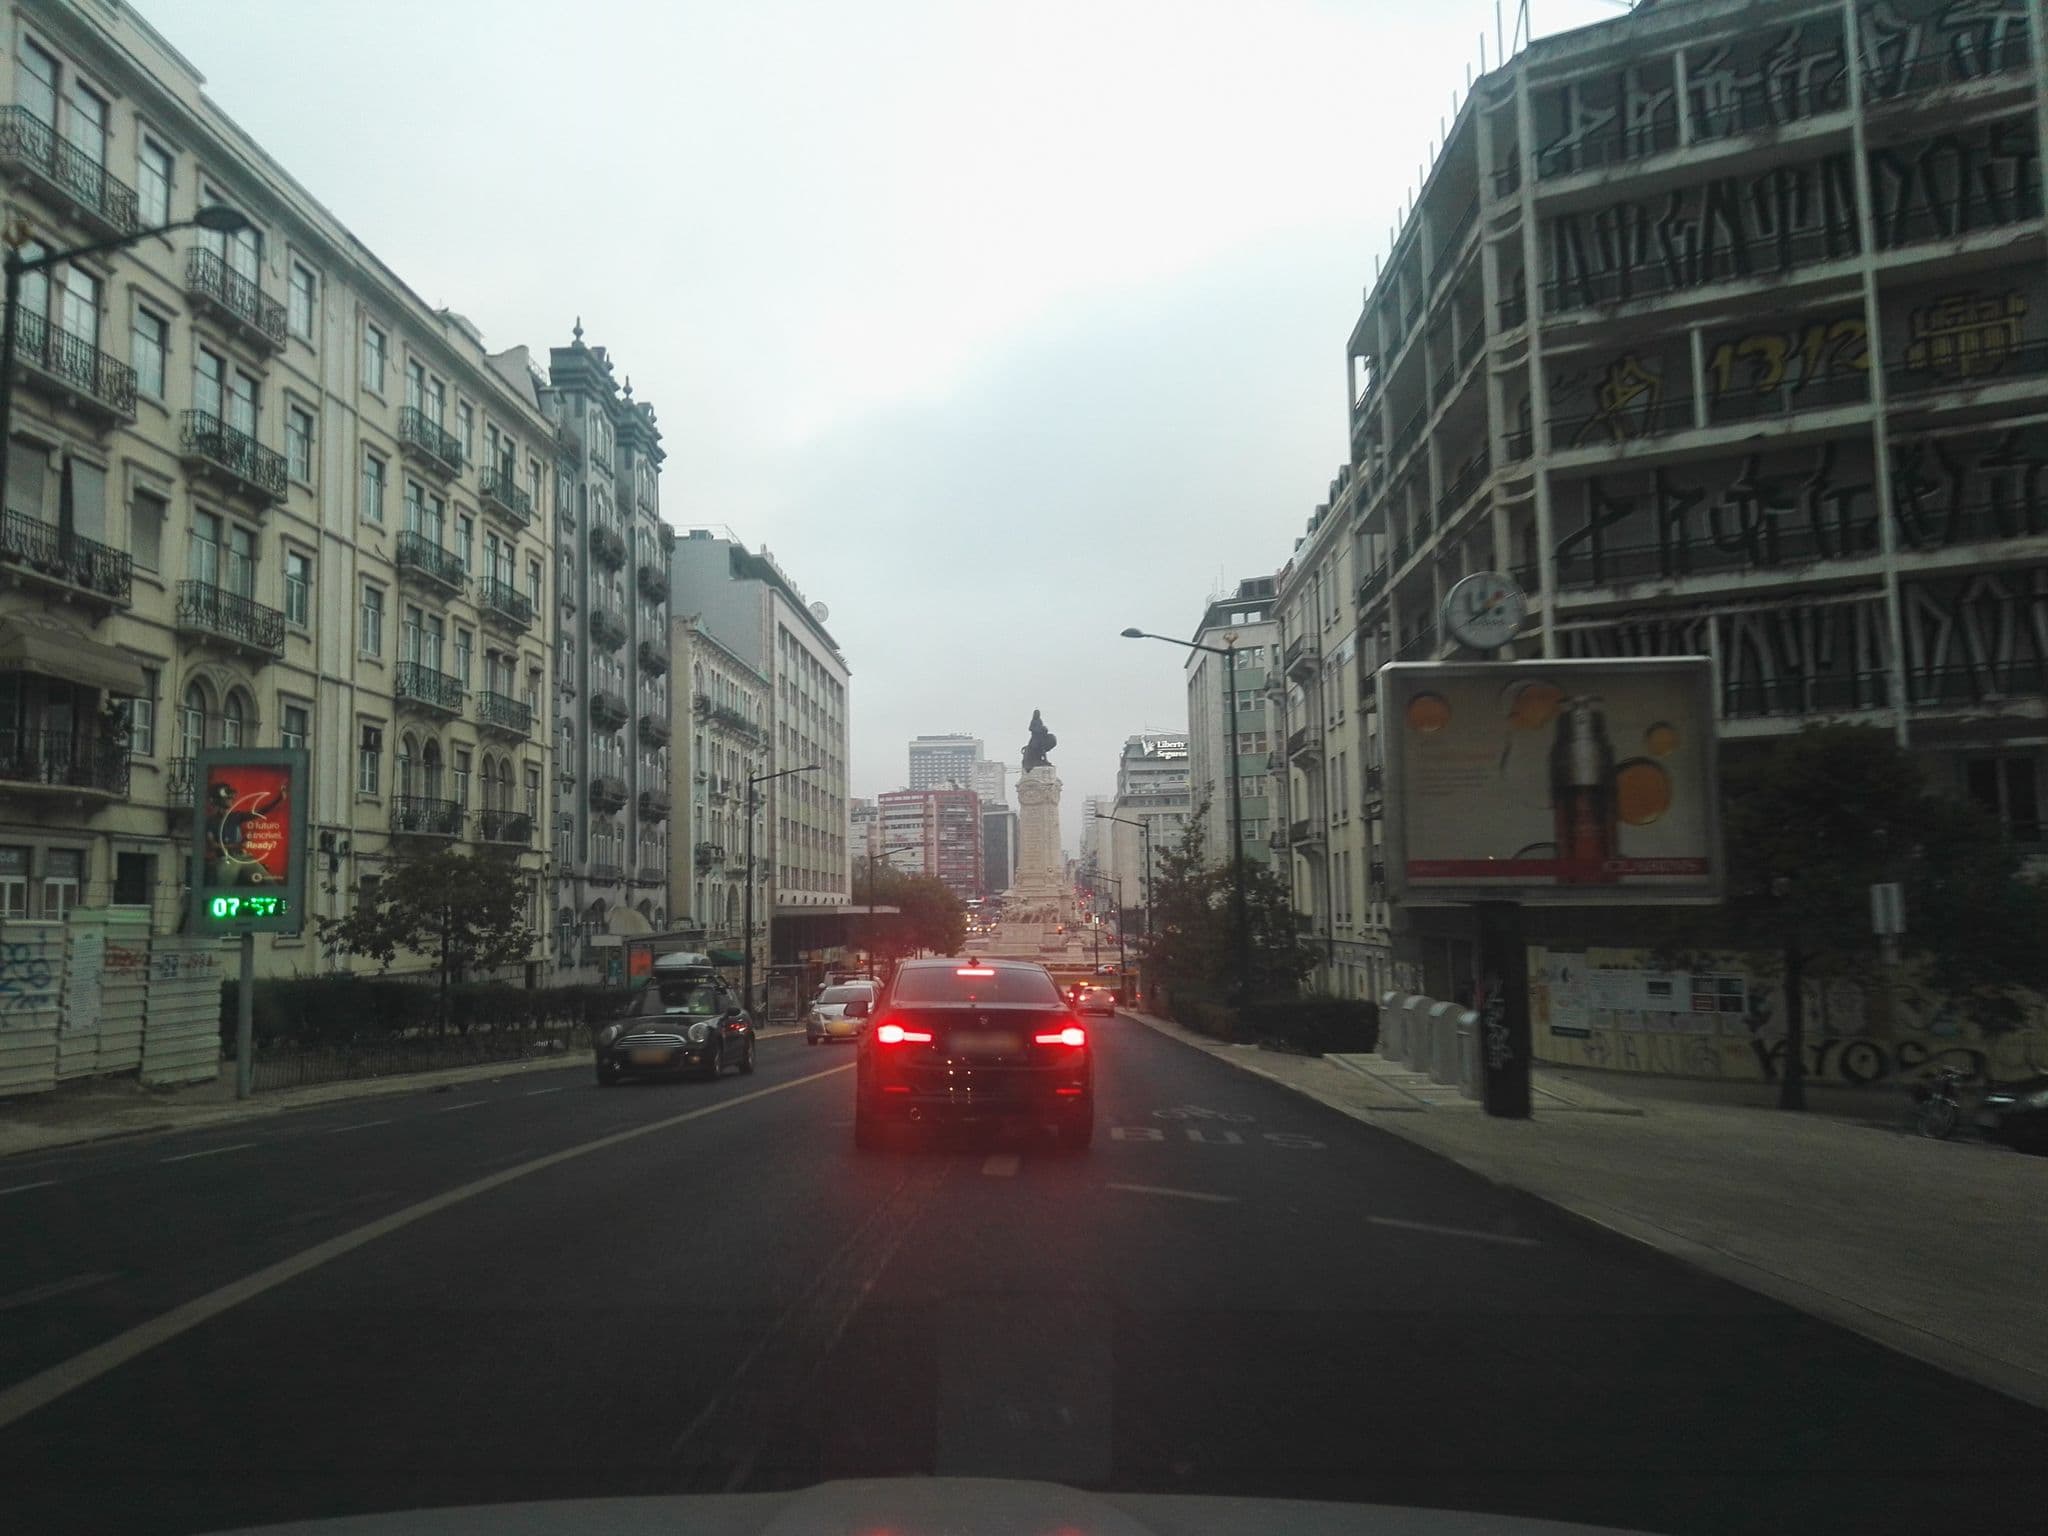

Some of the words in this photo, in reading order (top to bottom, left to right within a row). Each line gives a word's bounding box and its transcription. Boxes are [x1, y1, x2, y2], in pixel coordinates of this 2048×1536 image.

[1708, 319, 1871, 393] 1312
[247, 821, 254, 830] O
[256, 821, 280, 830] futuro
[247, 840, 277, 850] Ready?
[1110, 1126, 1328, 1149] BUS
